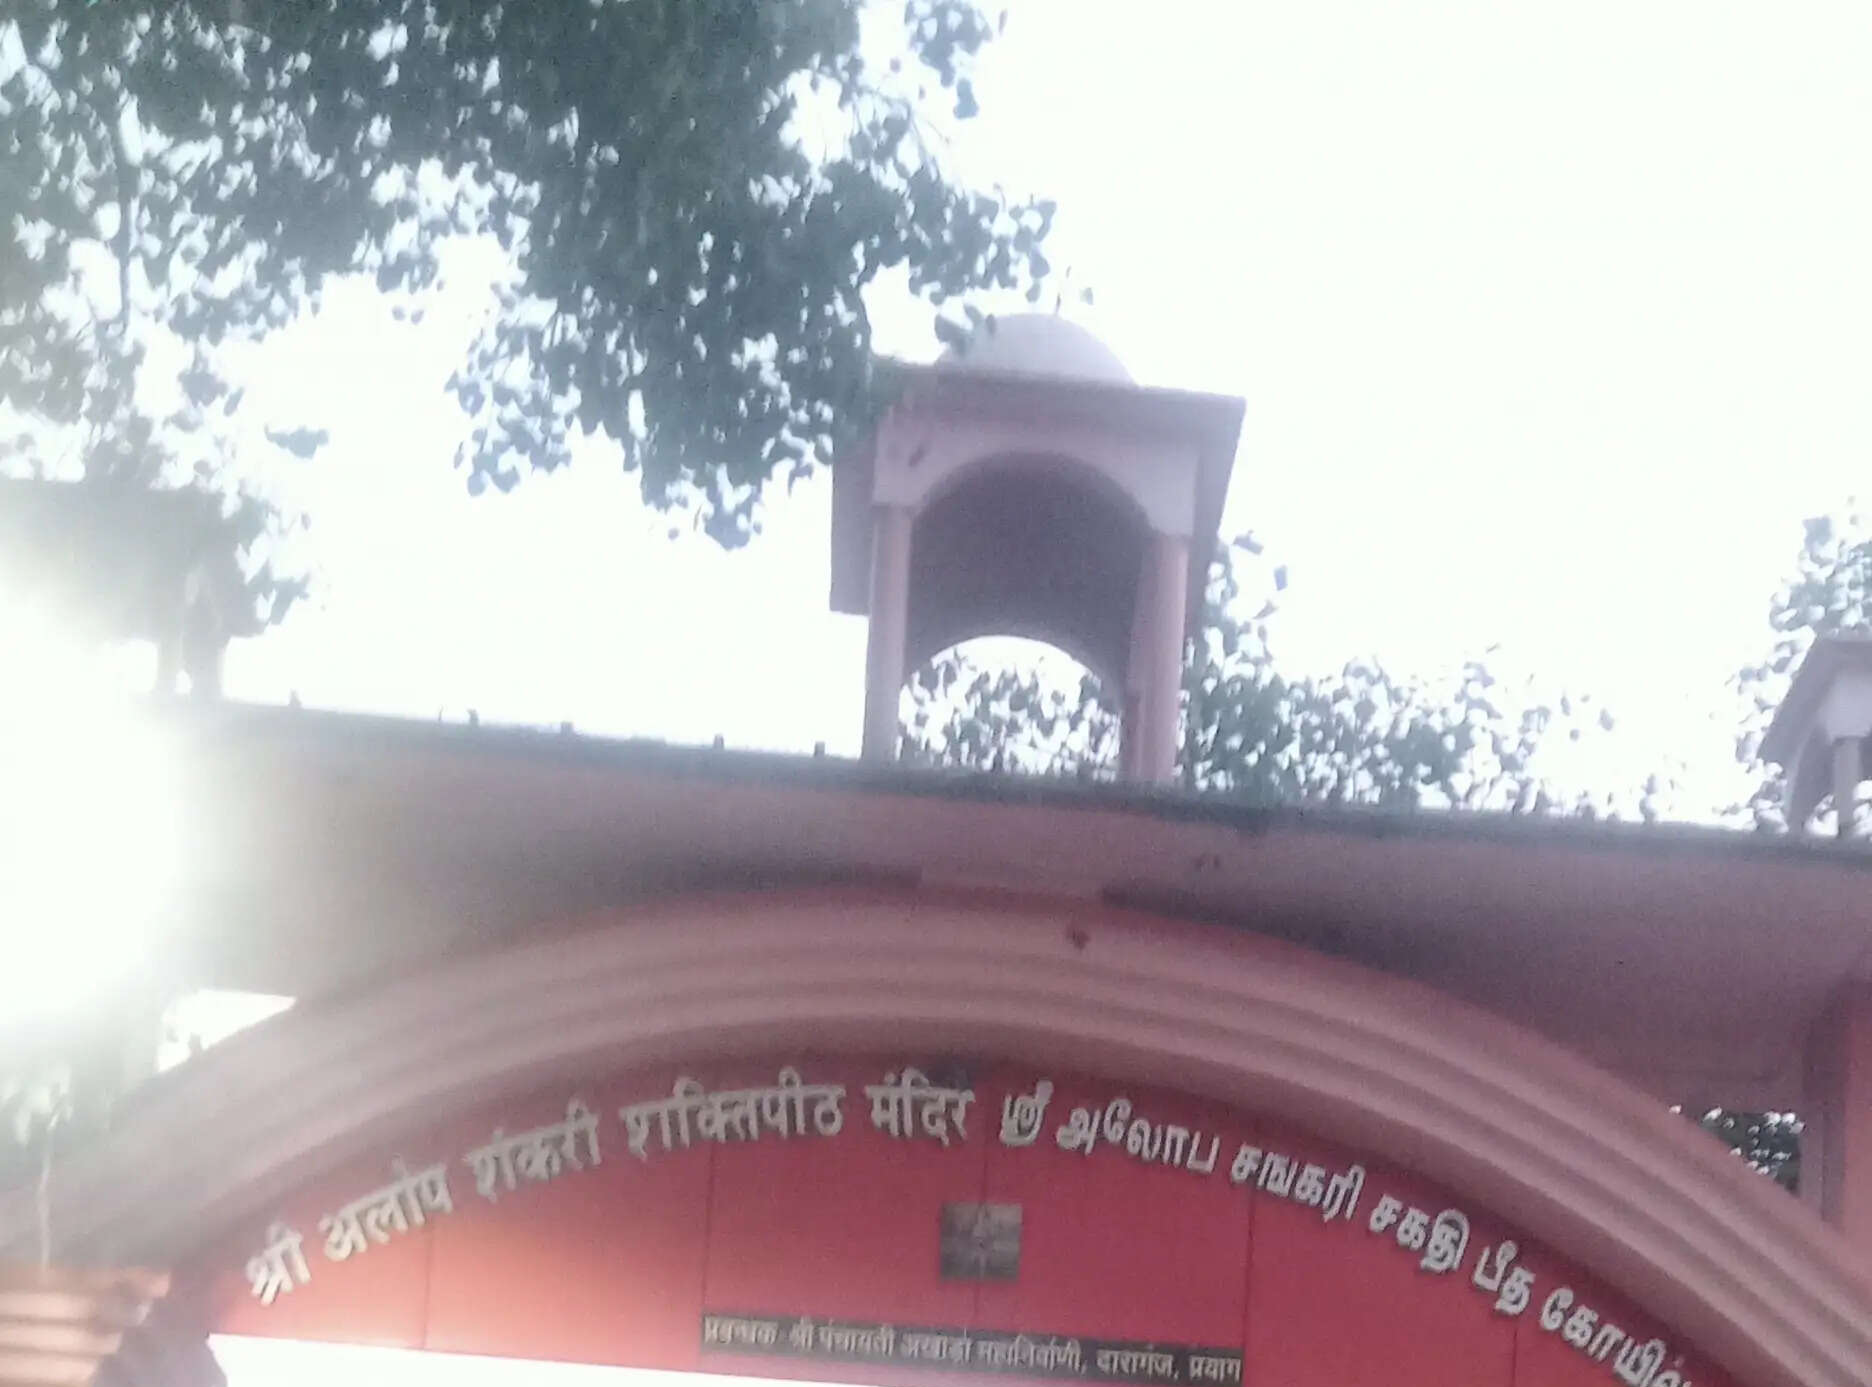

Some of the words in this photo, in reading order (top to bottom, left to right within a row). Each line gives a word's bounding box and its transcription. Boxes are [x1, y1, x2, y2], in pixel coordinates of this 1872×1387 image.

[246, 1221, 311, 1306] श्री
[318, 1153, 454, 1262] अलोप
[464, 1099, 601, 1202] शंकरी
[619, 1065, 847, 1161] शक्तिपीठ
[863, 1066, 976, 1147] मंदिर
[1056, 1097, 1221, 1174] அலோப
[1472, 1239, 1536, 1316] பீத
[1188, 1354, 1241, 1384] प्रयाग
